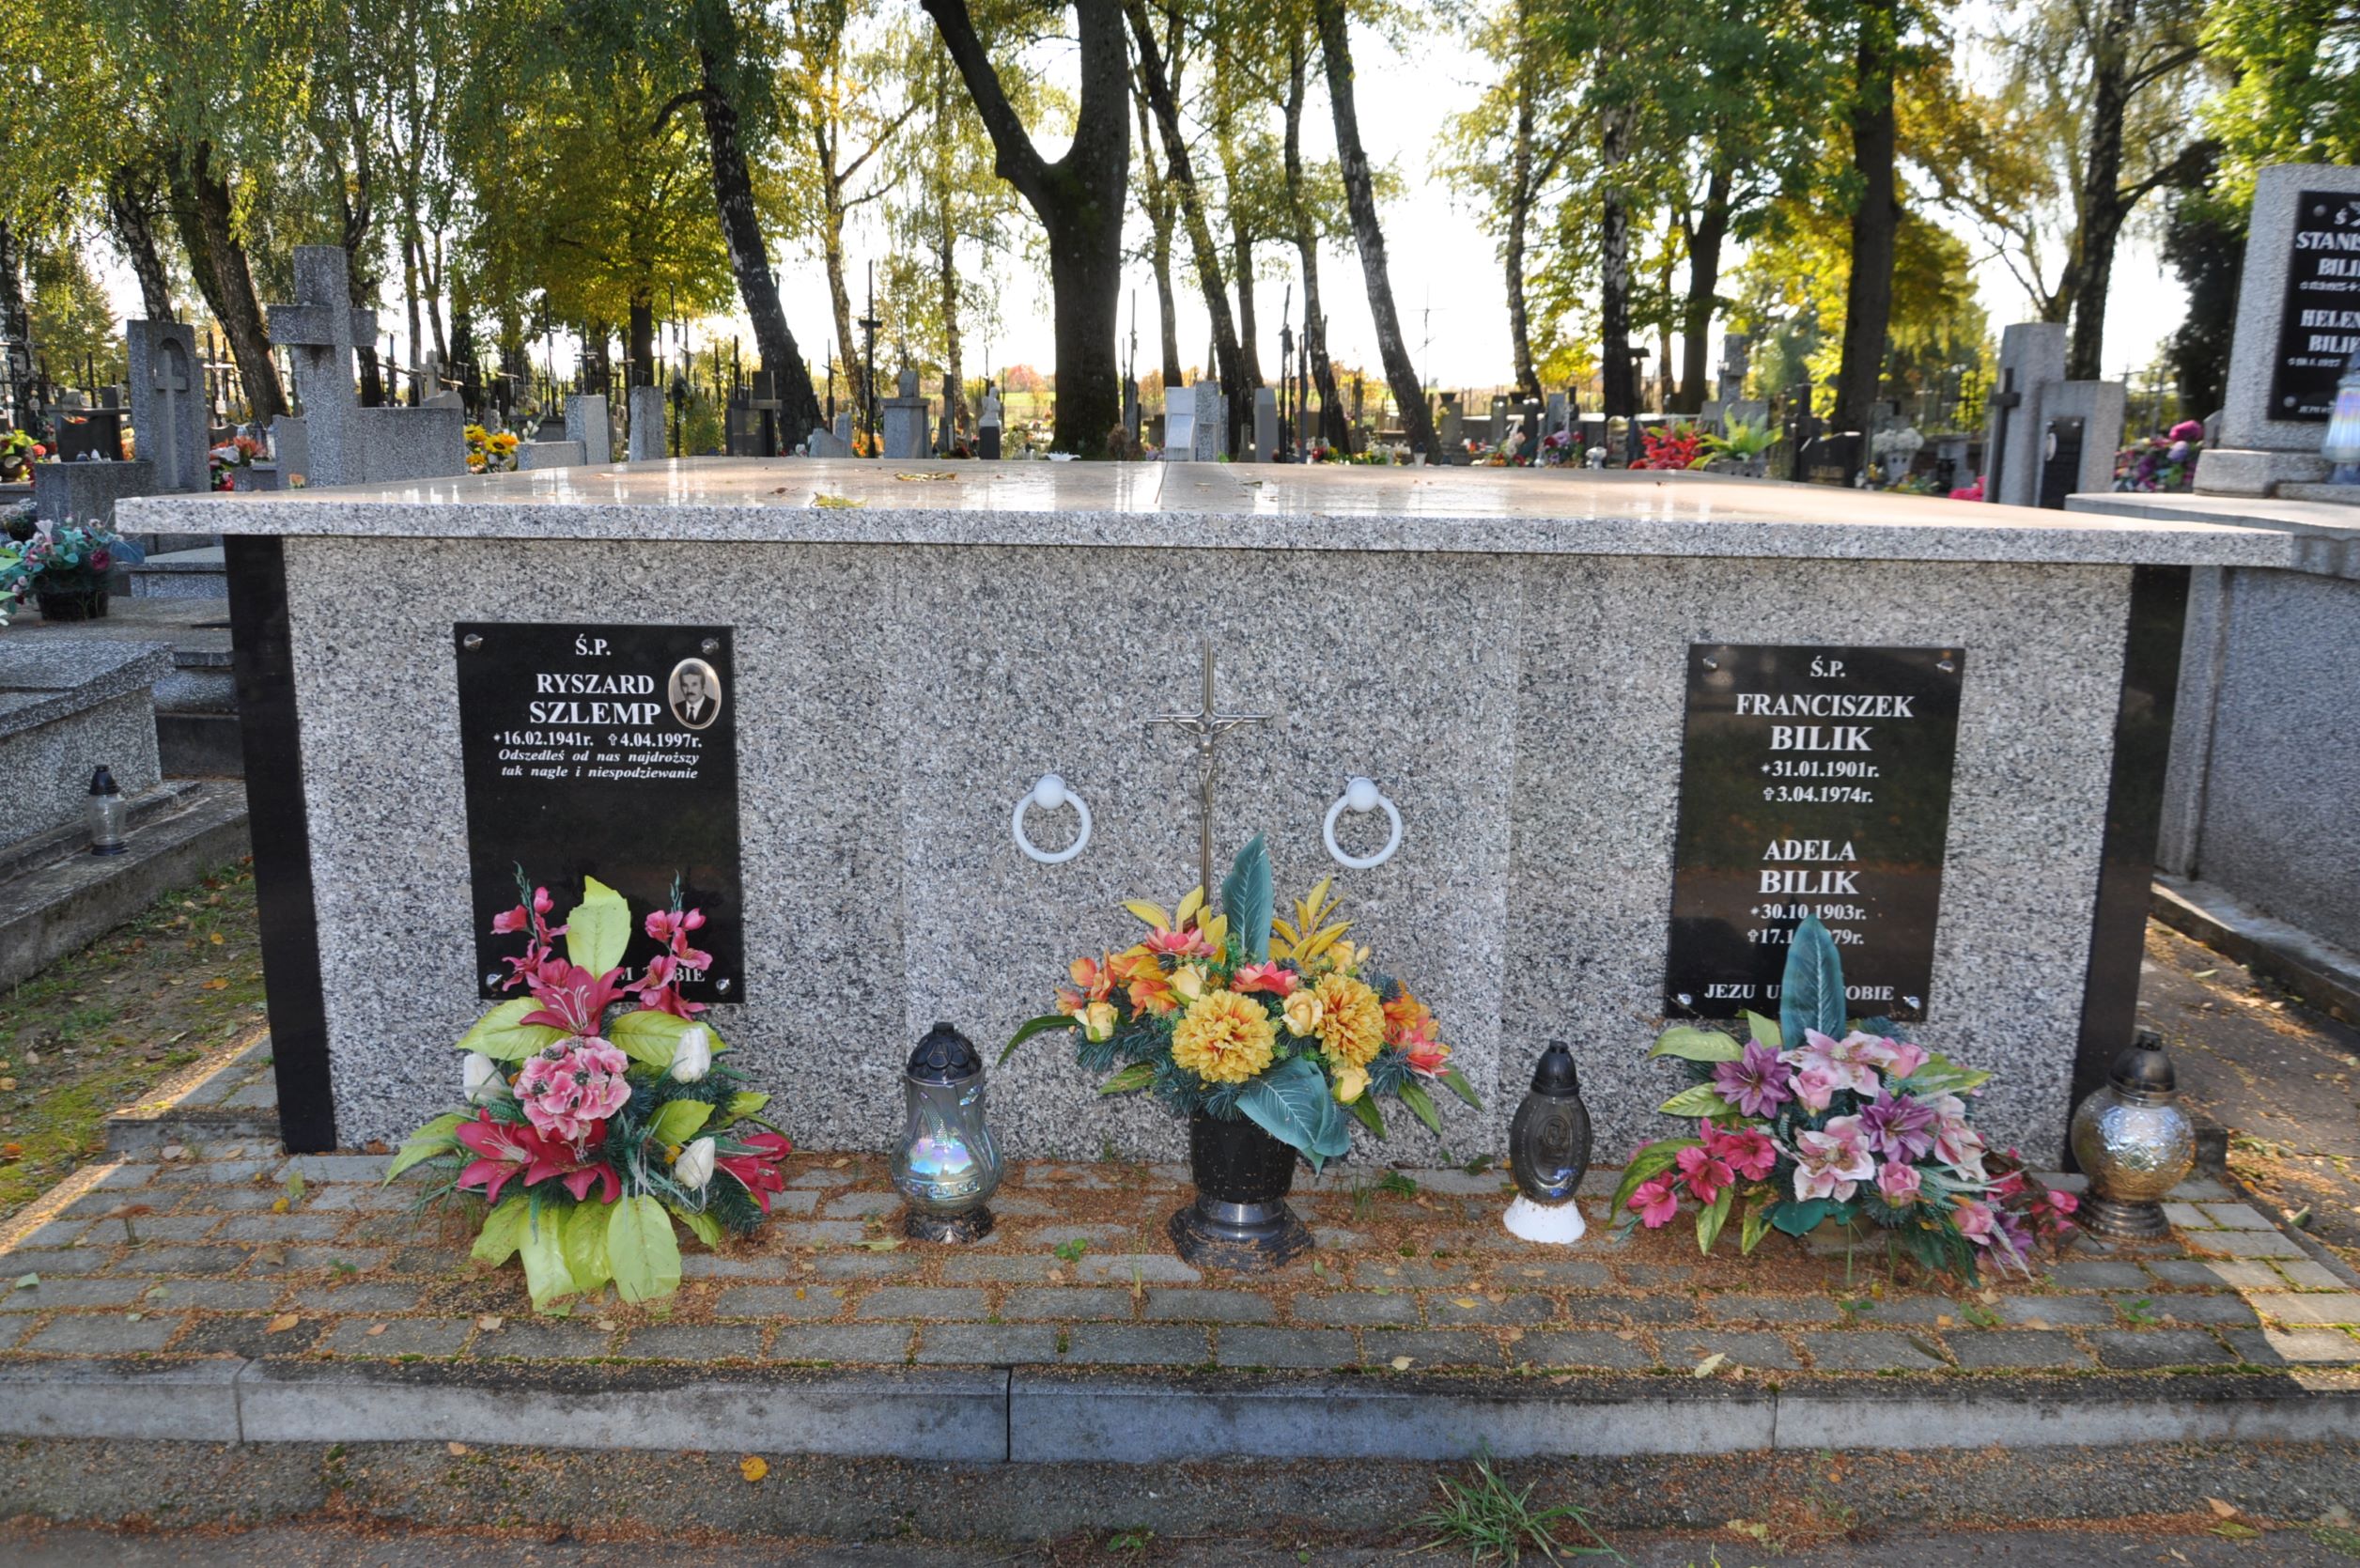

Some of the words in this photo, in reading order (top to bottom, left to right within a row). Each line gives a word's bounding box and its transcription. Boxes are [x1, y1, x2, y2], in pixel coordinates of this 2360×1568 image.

[576, 633, 612, 656] Ś.P.
[1809, 656, 1846, 677] Ś.P.
[536, 674, 655, 694] RYSZARD
[529, 701, 661, 725] SZLEMP
[1735, 693, 1915, 718] FRANCISZEK
[504, 731, 594, 747] 16.02.1941r.
[620, 733, 703, 748] 4.04.1997r.
[1769, 726, 1873, 751] BILIK
[498, 749, 566, 762] Odszedłeś
[572, 751, 590, 762] od
[597, 753, 621, 762] nas
[628, 751, 699, 766] najdroższy
[501, 766, 522, 777] tak
[531, 768, 568, 780] nagle
[575, 767, 582, 778] i
[588, 766, 698, 781] niespodziewanie
[1771, 760, 1880, 778] 31.01.1901r.
[1776, 786, 1873, 803] 3.04.1974r.
[1762, 840, 1855, 861] ADELA
[1758, 870, 1859, 894] BILIK
[1761, 904, 1867, 921] 30.101903r.
[1704, 984, 1755, 999] JEZU
[1843, 986, 1894, 1001] OBIE
